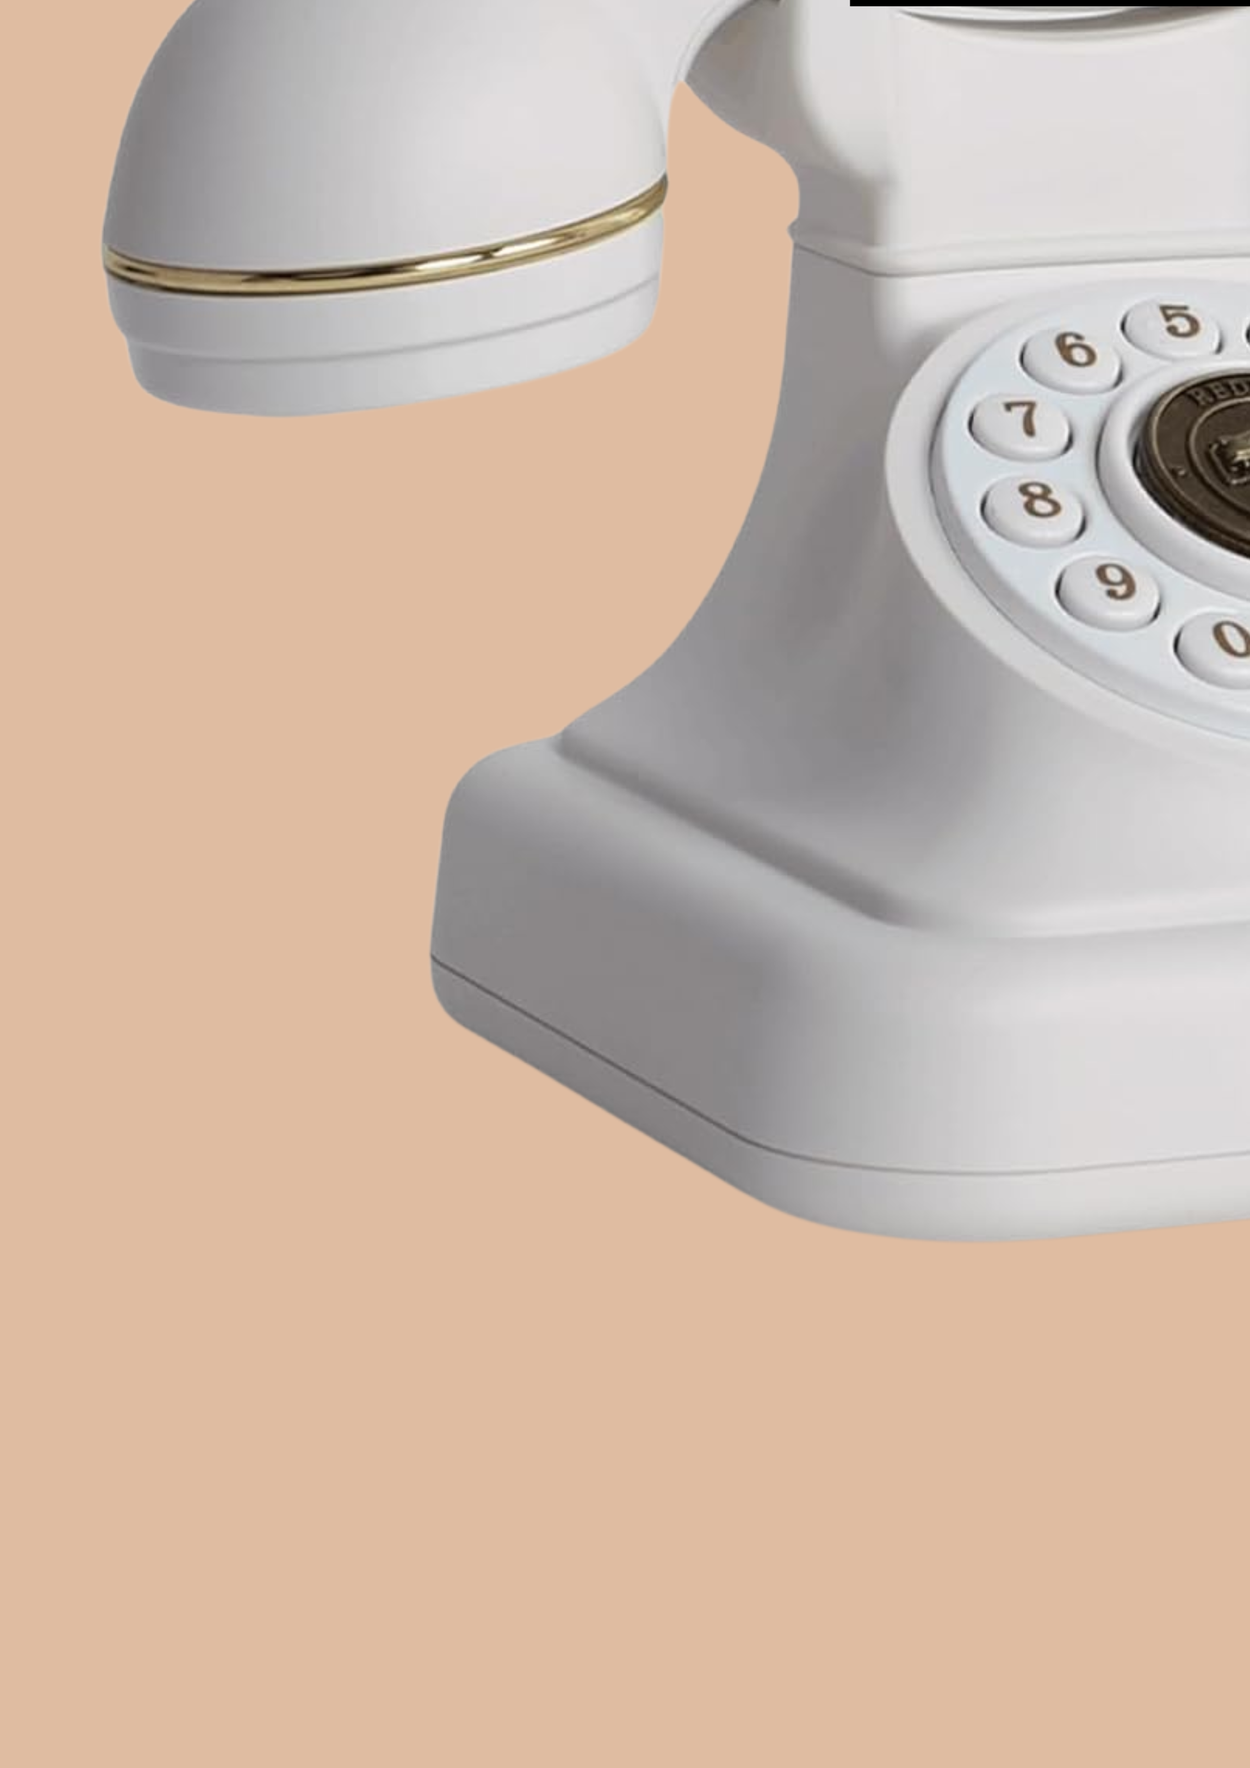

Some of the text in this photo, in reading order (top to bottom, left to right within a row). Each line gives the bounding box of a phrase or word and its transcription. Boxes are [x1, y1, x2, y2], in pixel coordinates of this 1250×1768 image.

[1158, 304, 1201, 339] 5
[1054, 331, 1097, 368] 6
[1002, 400, 1037, 438] 7
[1018, 481, 1062, 519] 8
[1094, 563, 1136, 601] 9
